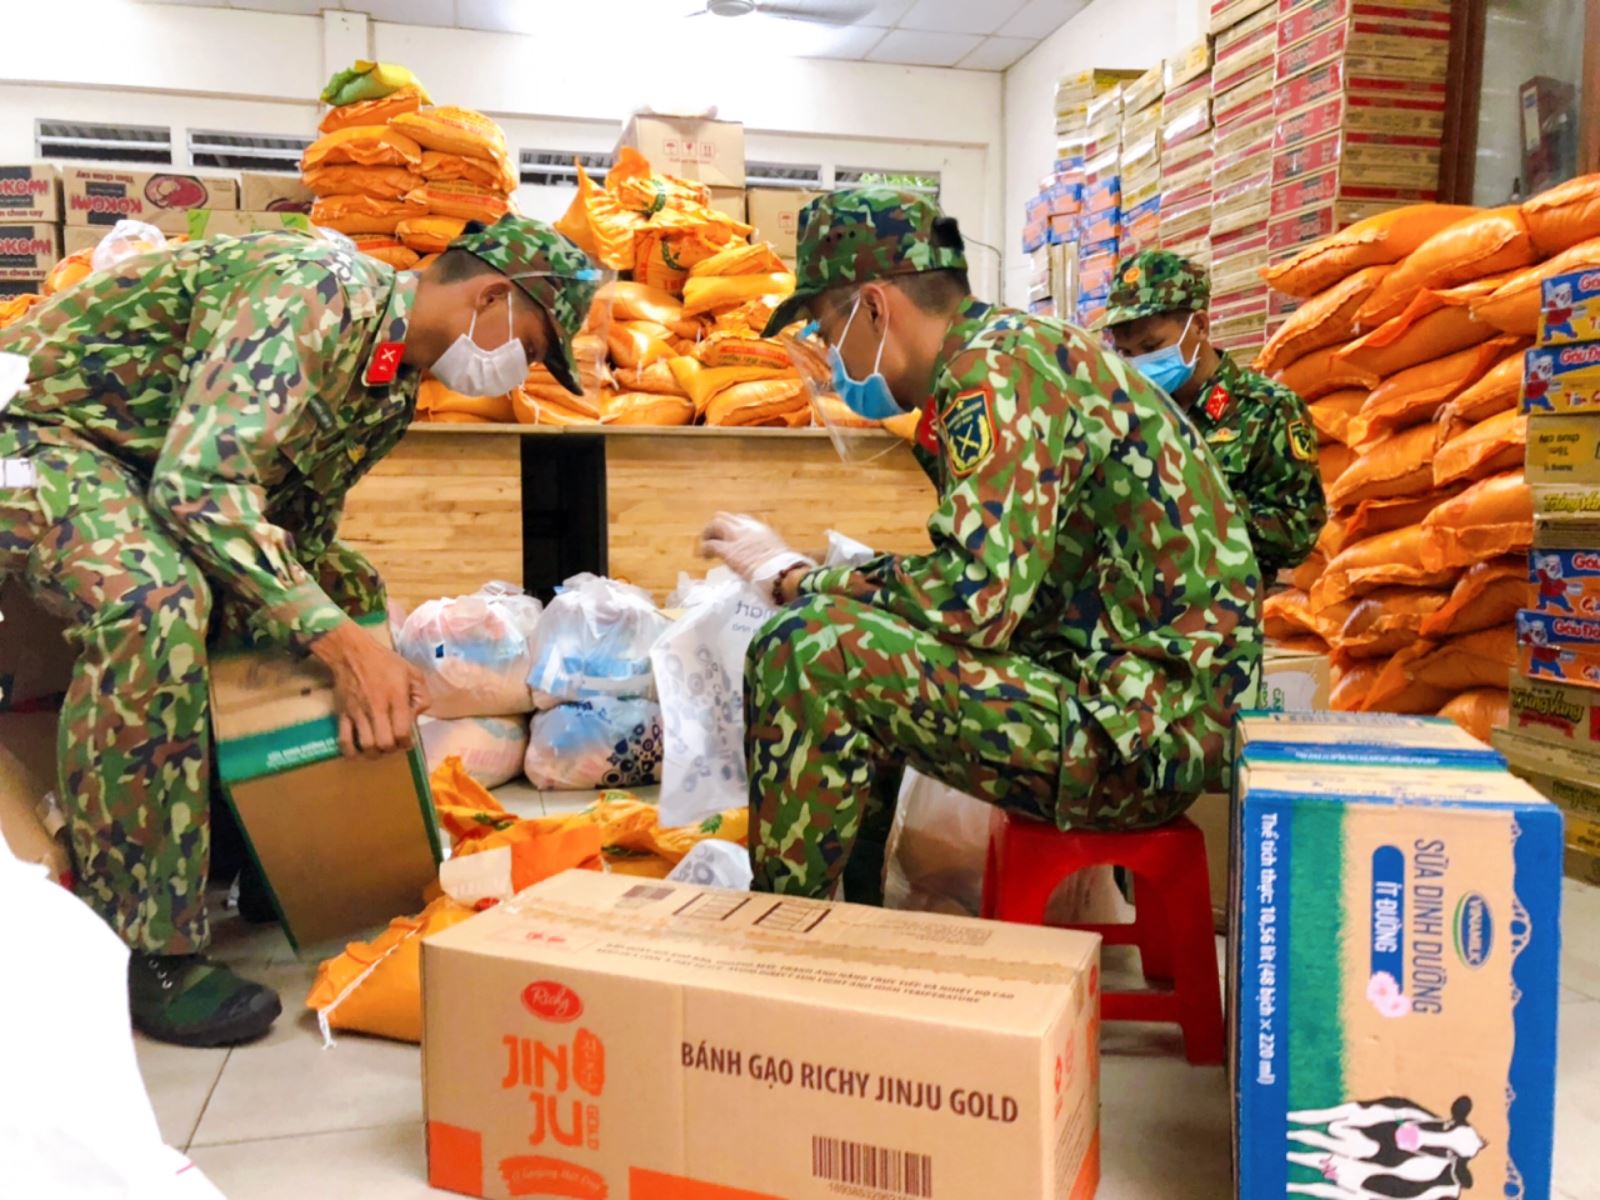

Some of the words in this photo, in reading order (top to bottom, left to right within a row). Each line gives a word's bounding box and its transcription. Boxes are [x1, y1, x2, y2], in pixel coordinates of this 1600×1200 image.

[1413, 838, 1450, 880] SỮA
[1375, 881, 1402, 897] ÍT
[1413, 885, 1444, 936] DINH
[1374, 898, 1403, 953] ĐƯỜNG
[1467, 897, 1483, 962] VINAMILK
[530, 985, 570, 1016] Richy
[1411, 940, 1448, 1015] DƯỠNG
[502, 1034, 568, 1092] JIN
[1259, 1032, 1276, 1059] 220
[681, 1040, 741, 1075] BÁNH
[748, 1054, 794, 1089] GẠO
[801, 1062, 870, 1098] RICHY
[874, 1075, 942, 1111] JINJU
[949, 1088, 1019, 1123] GOLD
[529, 1092, 583, 1147] JU
